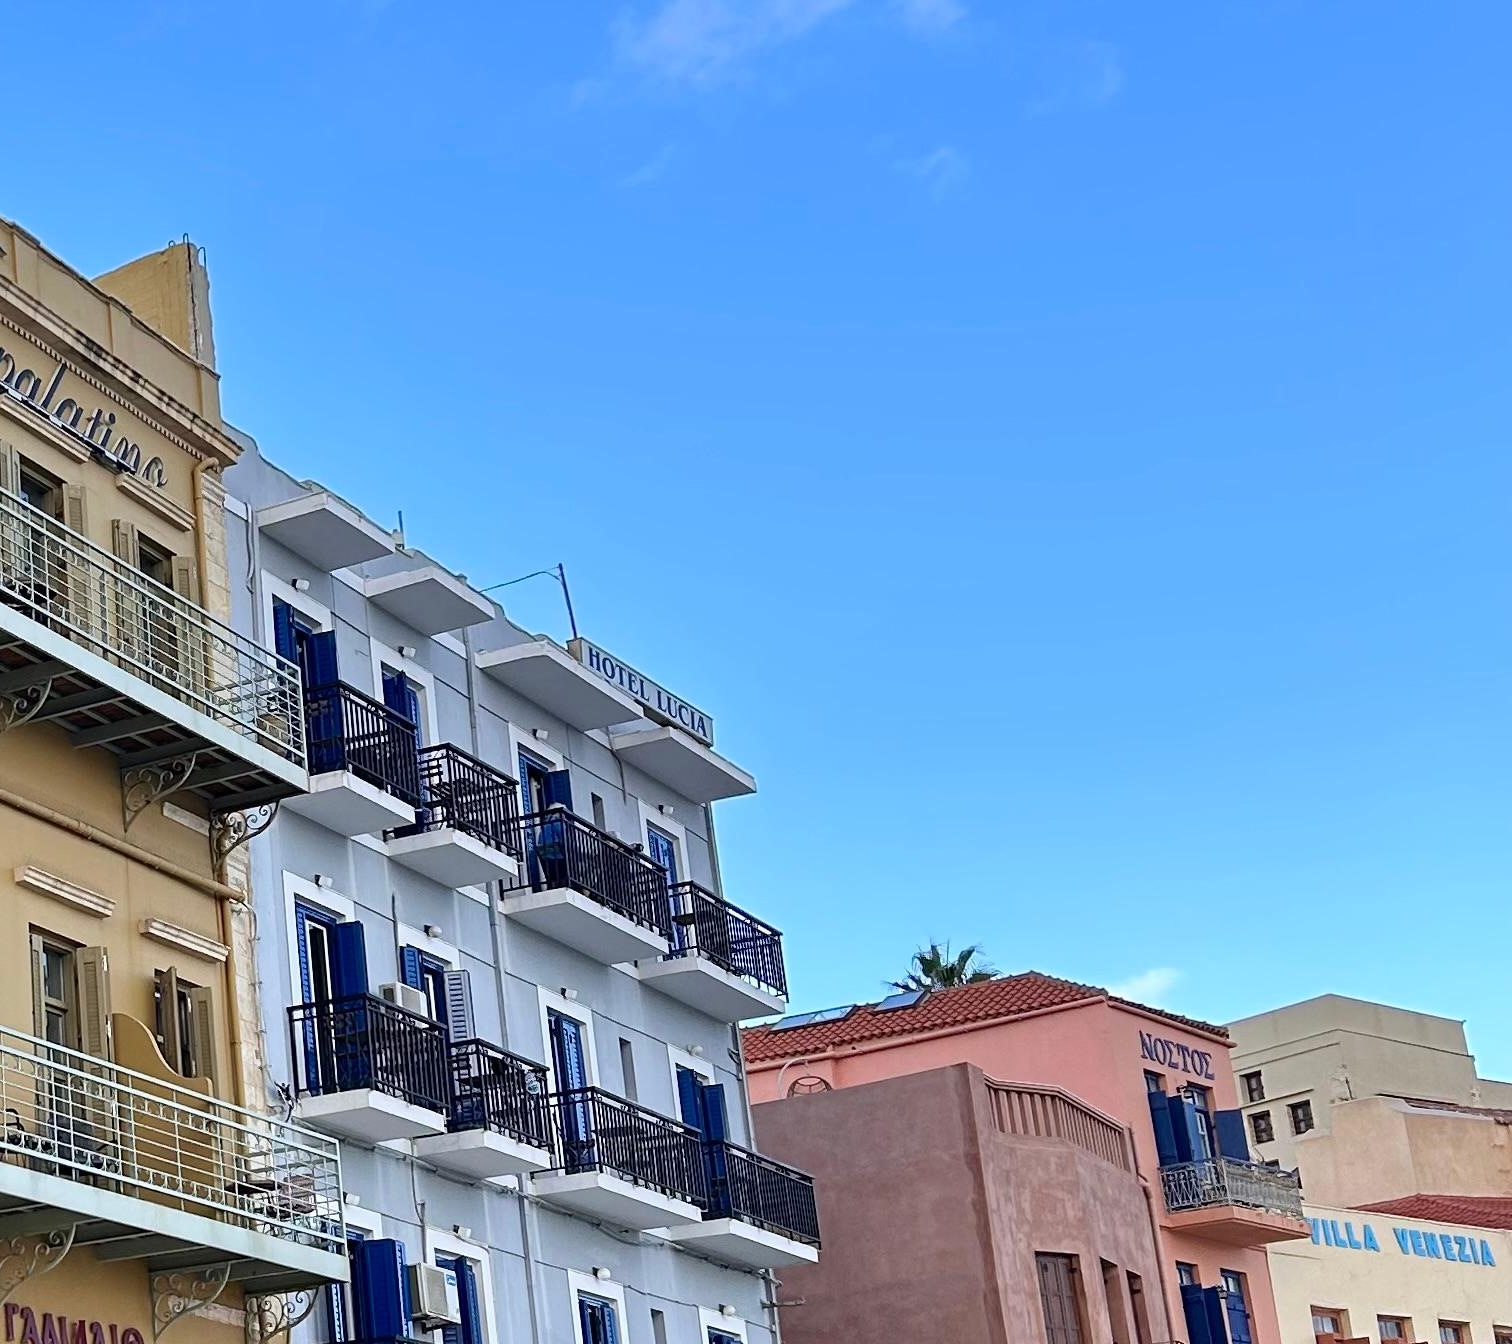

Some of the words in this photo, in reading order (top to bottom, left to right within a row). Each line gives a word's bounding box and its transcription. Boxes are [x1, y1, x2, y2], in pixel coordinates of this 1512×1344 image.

[587, 645, 650, 703] HOTEL
[656, 688, 709, 739] LUCIA
[1138, 1029, 1216, 1081] ΝΟΣΤΟΣ
[1306, 1216, 1381, 1253] VILLA
[1392, 1226, 1497, 1268] VENEZIA
